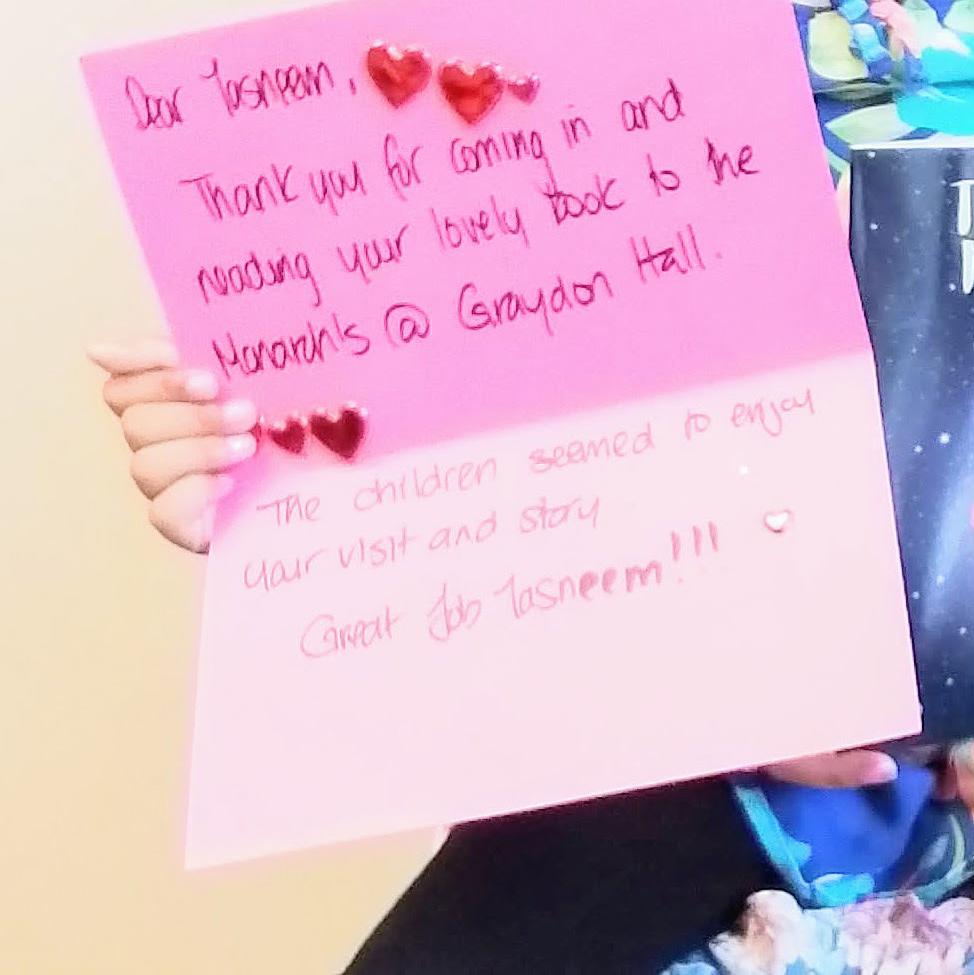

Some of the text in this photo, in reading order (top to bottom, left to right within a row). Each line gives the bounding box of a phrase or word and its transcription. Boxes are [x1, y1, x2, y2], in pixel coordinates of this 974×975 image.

[125, 75, 184, 130] Dear
[178, 78, 685, 220] Thank you for coming in and
[197, 249, 321, 307] reading
[337, 224, 408, 284] your
[430, 194, 530, 250] lovely
[543, 175, 625, 225] book
[647, 153, 680, 197] to
[384, 302, 430, 347] @
[458, 271, 613, 337] Graydon
[256, 388, 816, 526] The children seemed to enjoy
[244, 496, 600, 591] your visit and story
[300, 605, 400, 659] Great
[427, 582, 482, 643] Job
